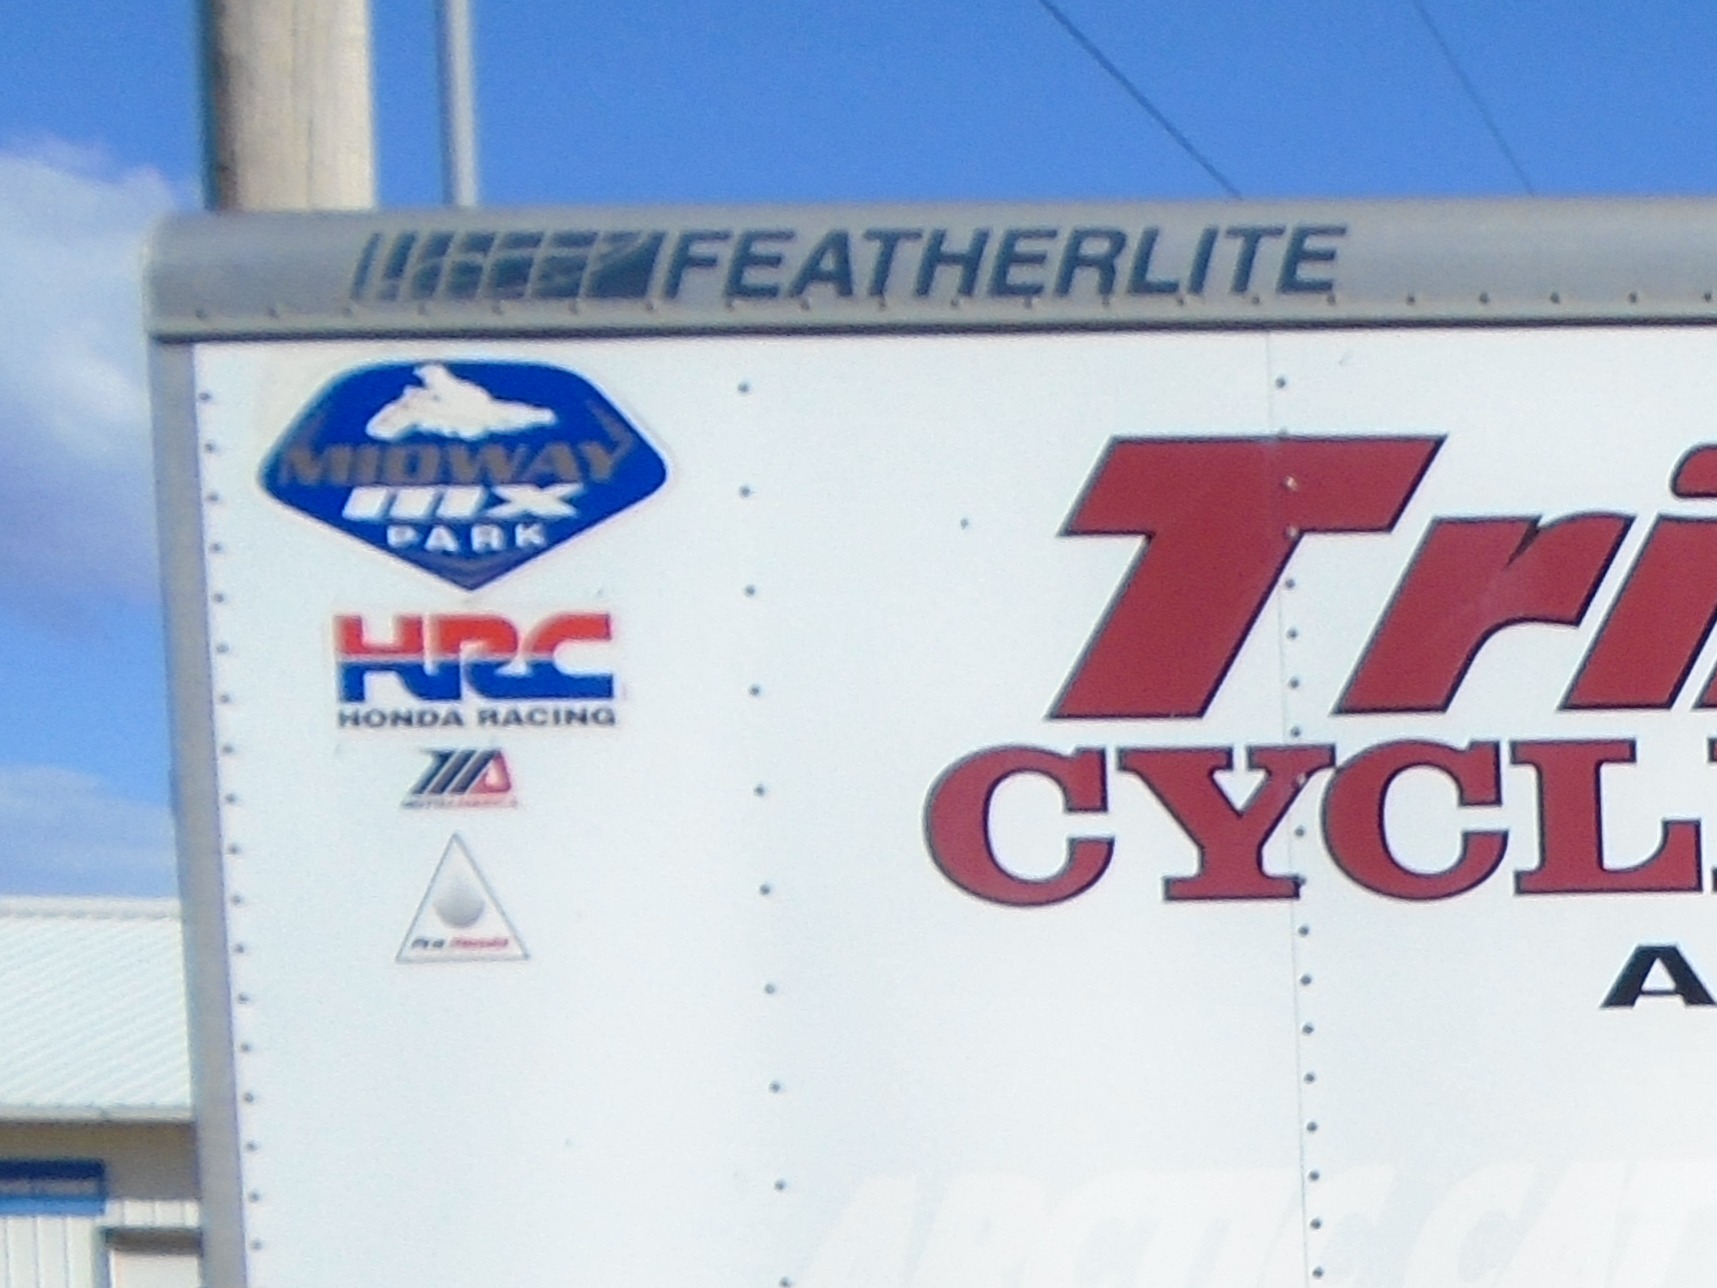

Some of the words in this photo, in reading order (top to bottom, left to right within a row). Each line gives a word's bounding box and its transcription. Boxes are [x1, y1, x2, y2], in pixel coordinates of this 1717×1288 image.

[655, 226, 1347, 302] FEATHERLITE
[278, 441, 630, 485] MIDWAY
[386, 523, 546, 552] PARK
[335, 613, 615, 704] HRC
[337, 708, 465, 728] HONDA
[476, 707, 617, 728] RACING
